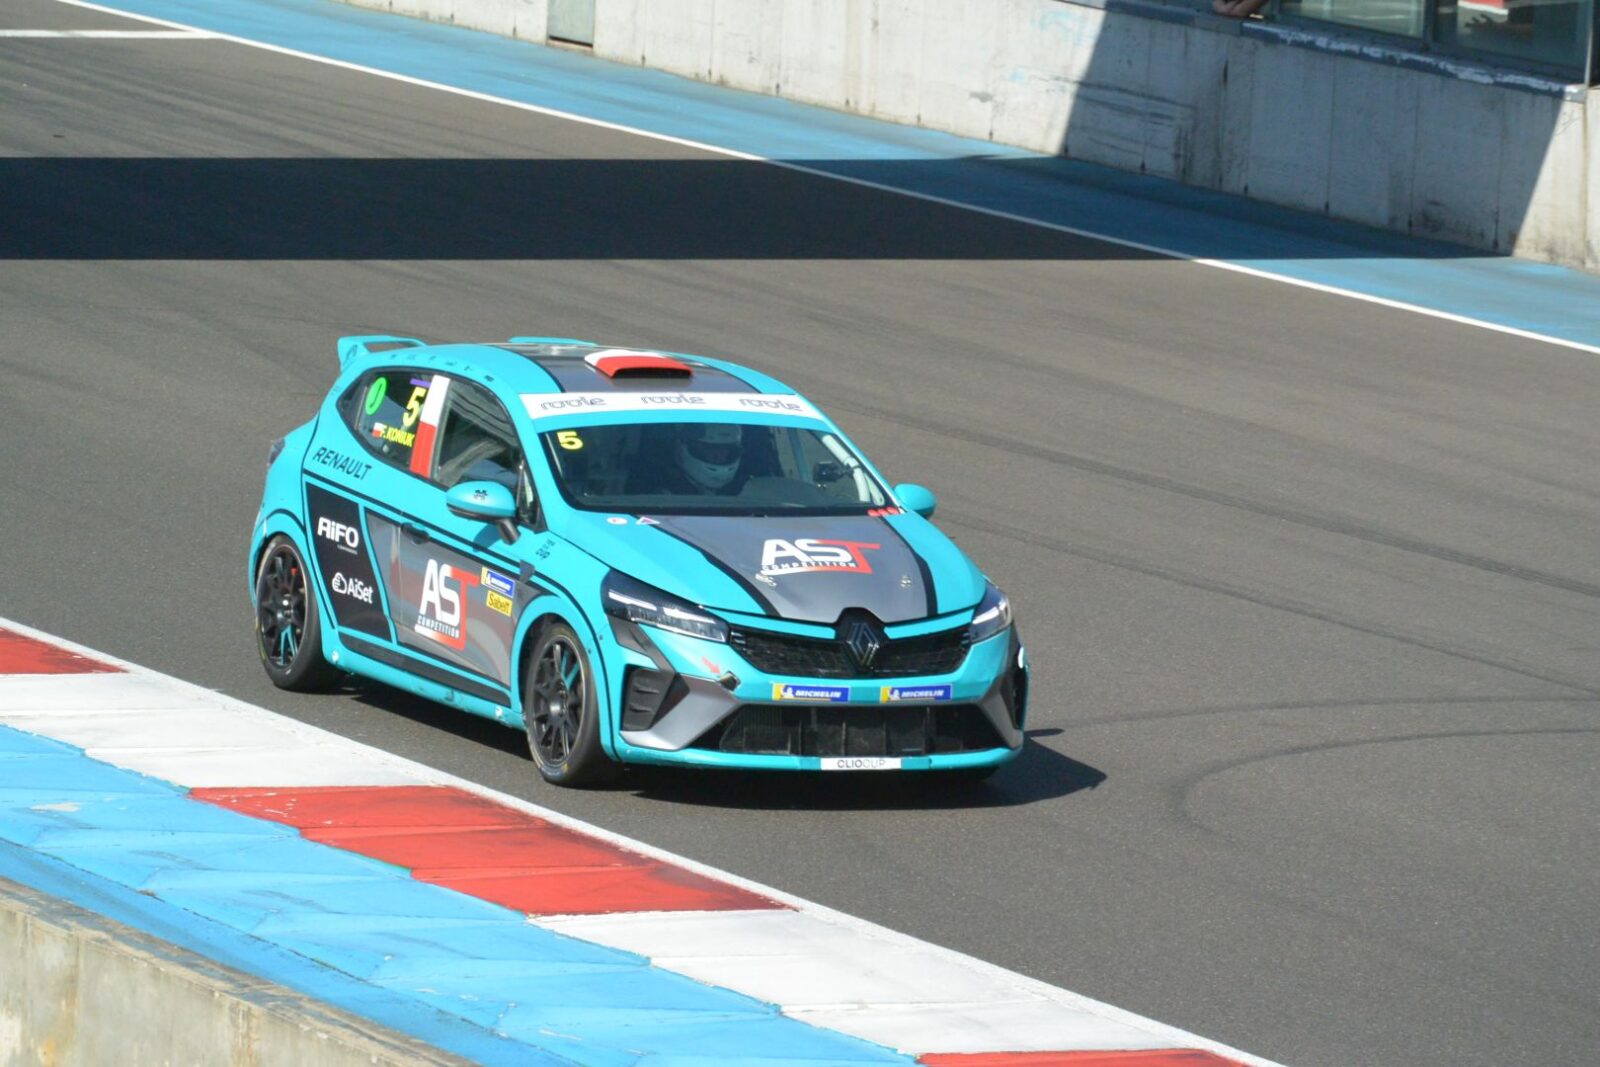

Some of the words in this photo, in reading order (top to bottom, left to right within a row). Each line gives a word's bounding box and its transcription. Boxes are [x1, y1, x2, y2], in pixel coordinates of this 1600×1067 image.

[402, 386, 427, 427] 5
[556, 431, 583, 449] 5
[312, 447, 372, 480] RENAULT
[761, 538, 880, 574] AST
[761, 561, 857, 572] COMPETITION
[347, 577, 374, 604] AiSet
[419, 559, 480, 650] AST
[417, 614, 460, 639] COMPETITION
[795, 689, 842, 698] MICHELIN
[901, 689, 944, 698] MICHELIN
